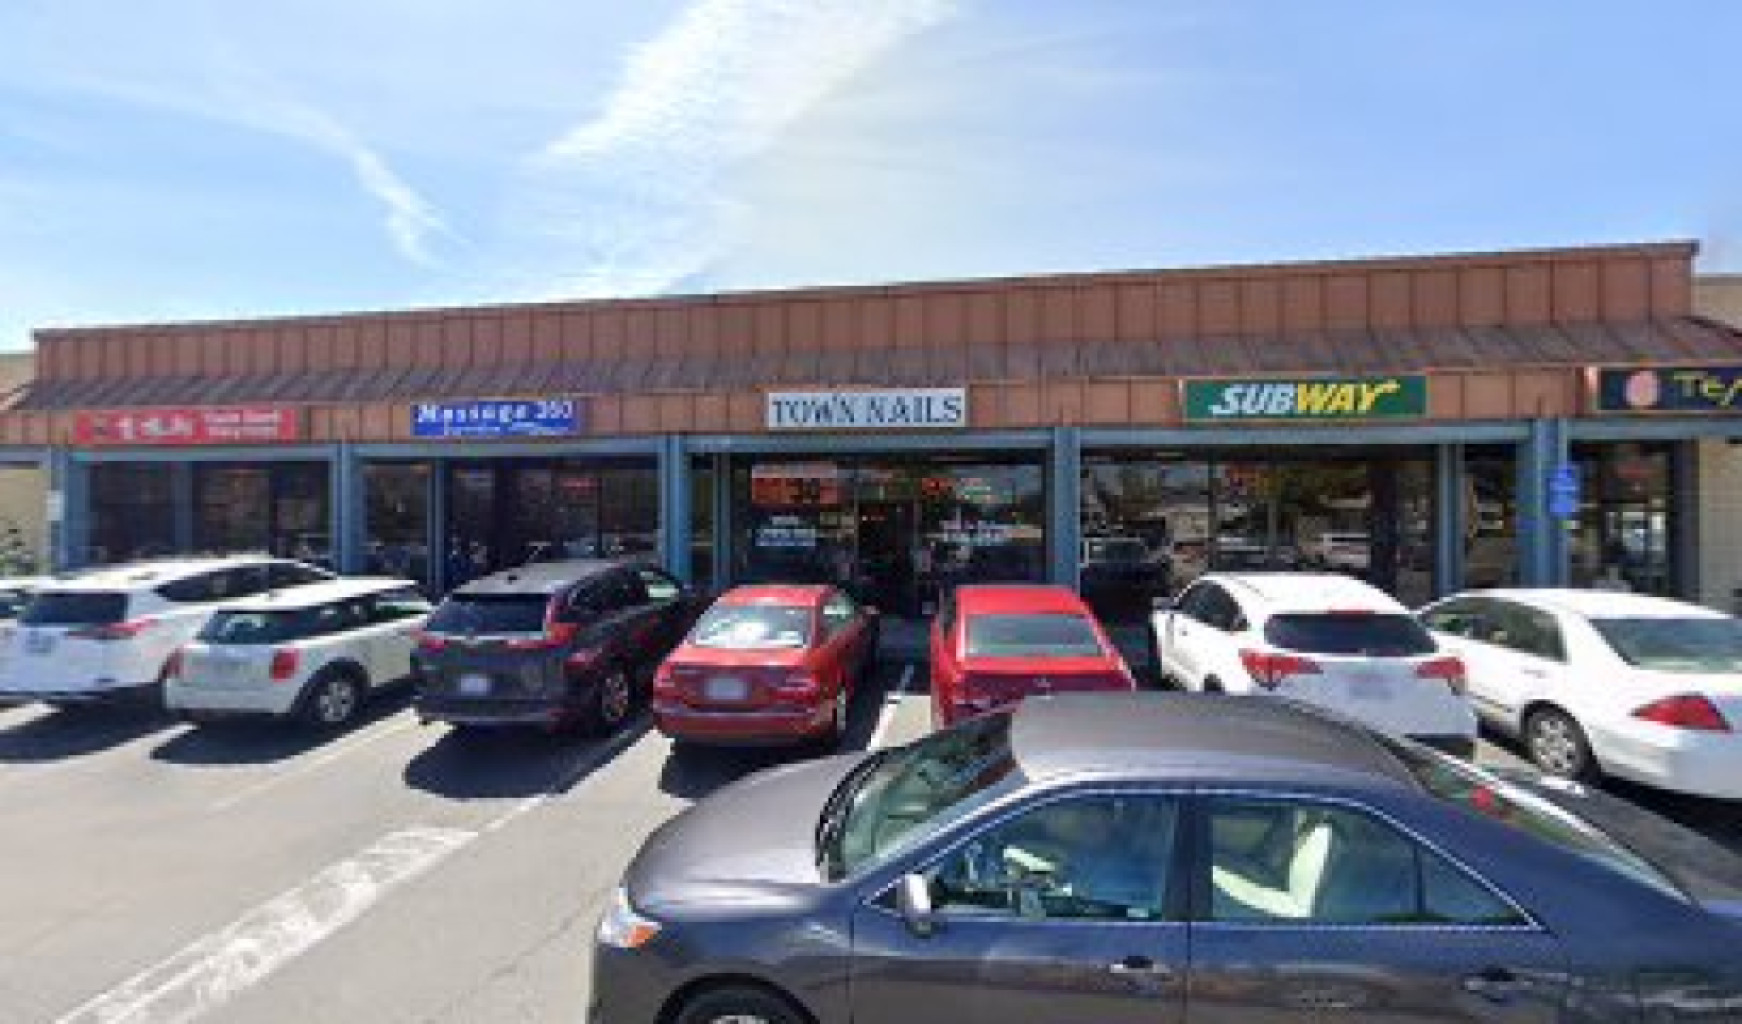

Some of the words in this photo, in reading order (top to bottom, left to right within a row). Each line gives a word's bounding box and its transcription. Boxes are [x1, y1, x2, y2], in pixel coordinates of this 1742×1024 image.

[772, 395, 855, 423] TOWN
[866, 396, 962, 423] NAILS
[1208, 380, 1400, 415] SUBWAY
[417, 403, 528, 423] Massage
